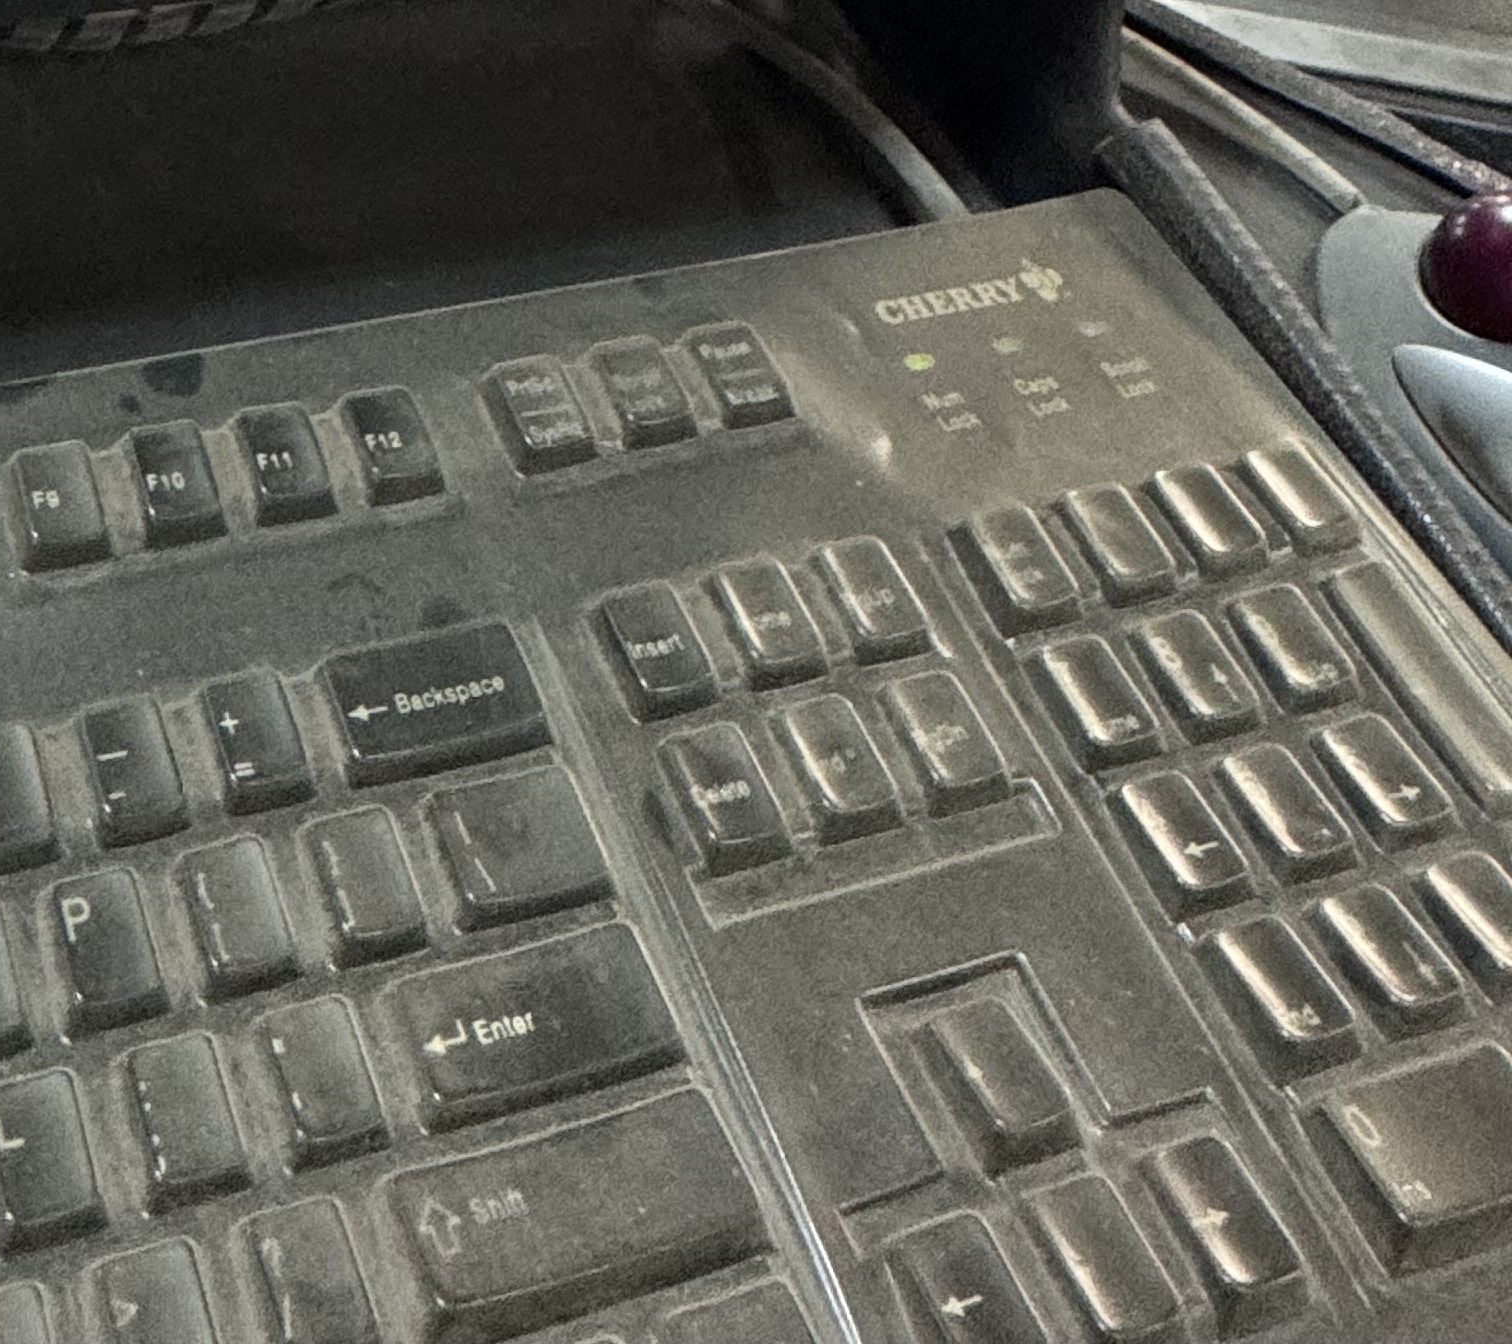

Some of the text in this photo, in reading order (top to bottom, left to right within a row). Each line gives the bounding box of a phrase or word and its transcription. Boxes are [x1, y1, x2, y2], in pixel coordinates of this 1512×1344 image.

[875, 274, 1025, 325] CHERRY
[146, 471, 186, 491] F10
[394, 674, 505, 715] Backspace
[60, 896, 92, 944] P
[472, 1012, 536, 1046] Enter
